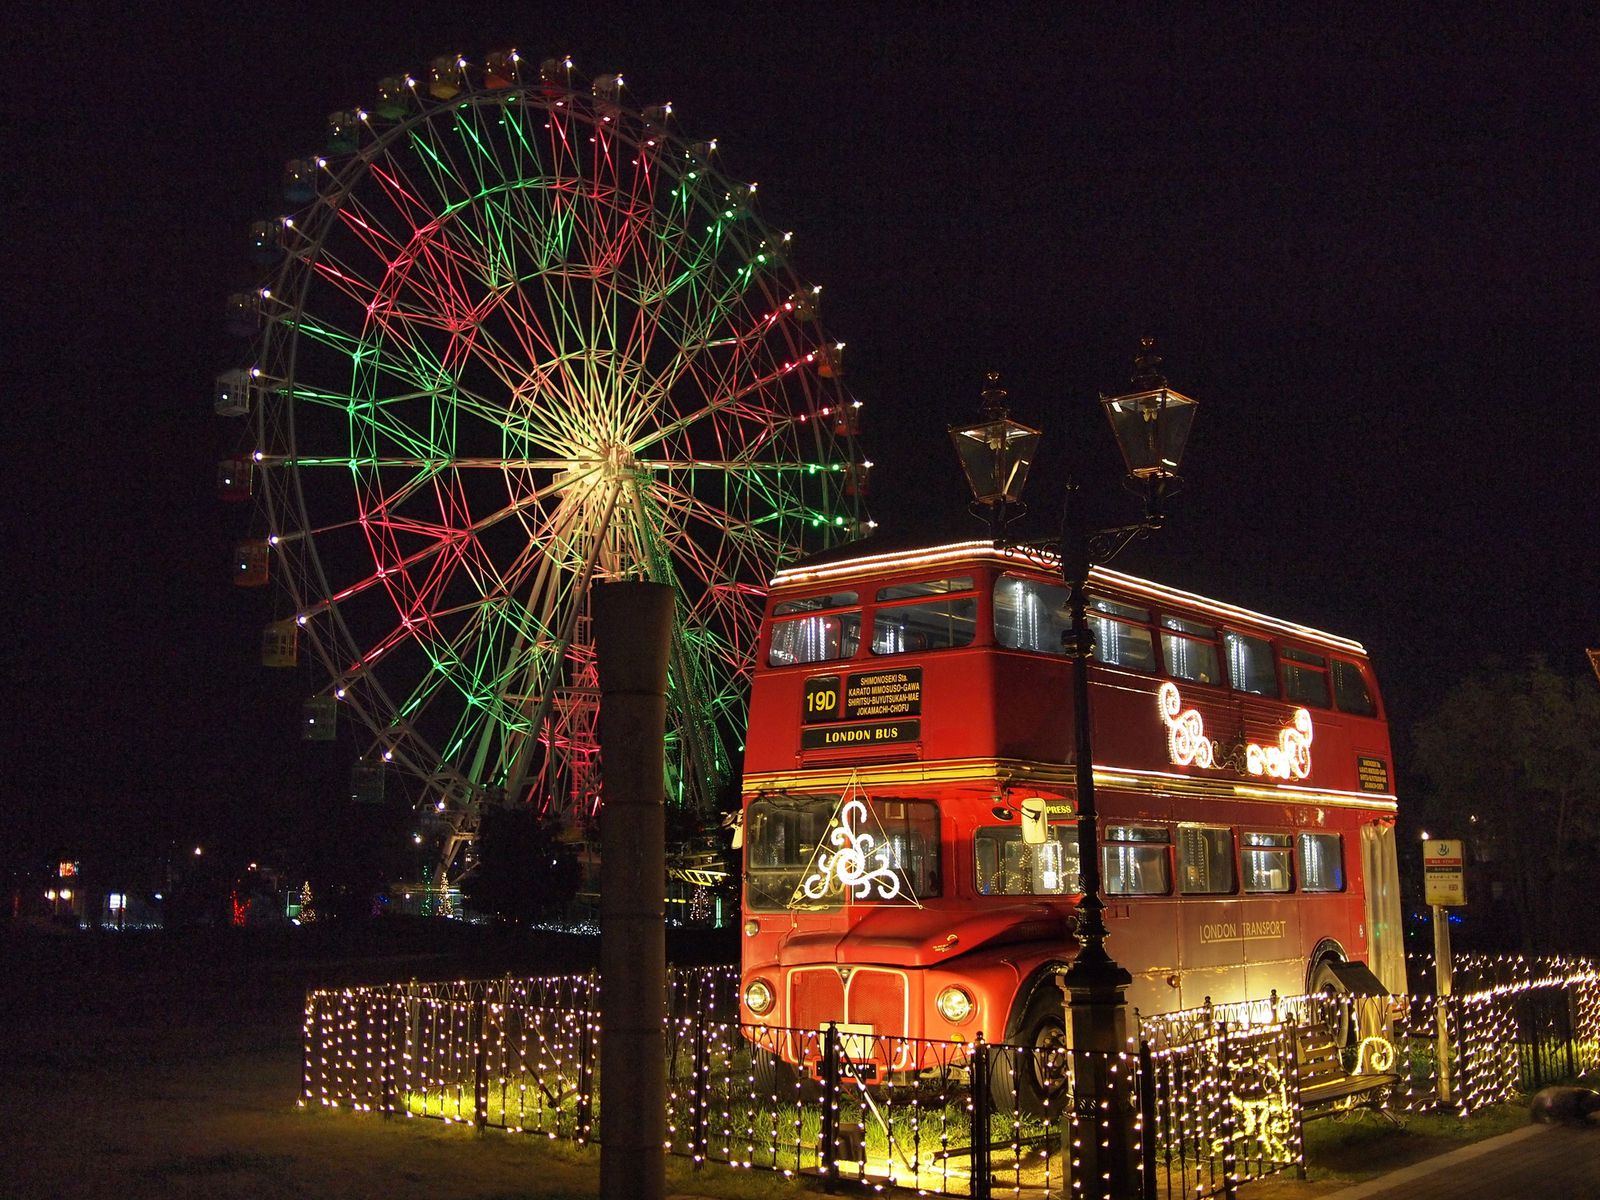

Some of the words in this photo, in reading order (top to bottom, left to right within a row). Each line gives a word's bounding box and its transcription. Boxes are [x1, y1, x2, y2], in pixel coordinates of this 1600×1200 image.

[860, 674, 897, 686] SHIMONOSEKI
[848, 686, 870, 697] KARATO
[871, 682, 920, 694] MIMOSUSO-GAWA
[807, 690, 836, 711] 19D
[857, 703, 909, 716] JOKAMACHI-CHOFU
[825, 729, 871, 743] LONDON
[876, 727, 898, 739] BUS
[1046, 805, 1072, 814] PRESS
[1199, 923, 1236, 944] LONDON
[1242, 920, 1286, 937] TRANSPORT
